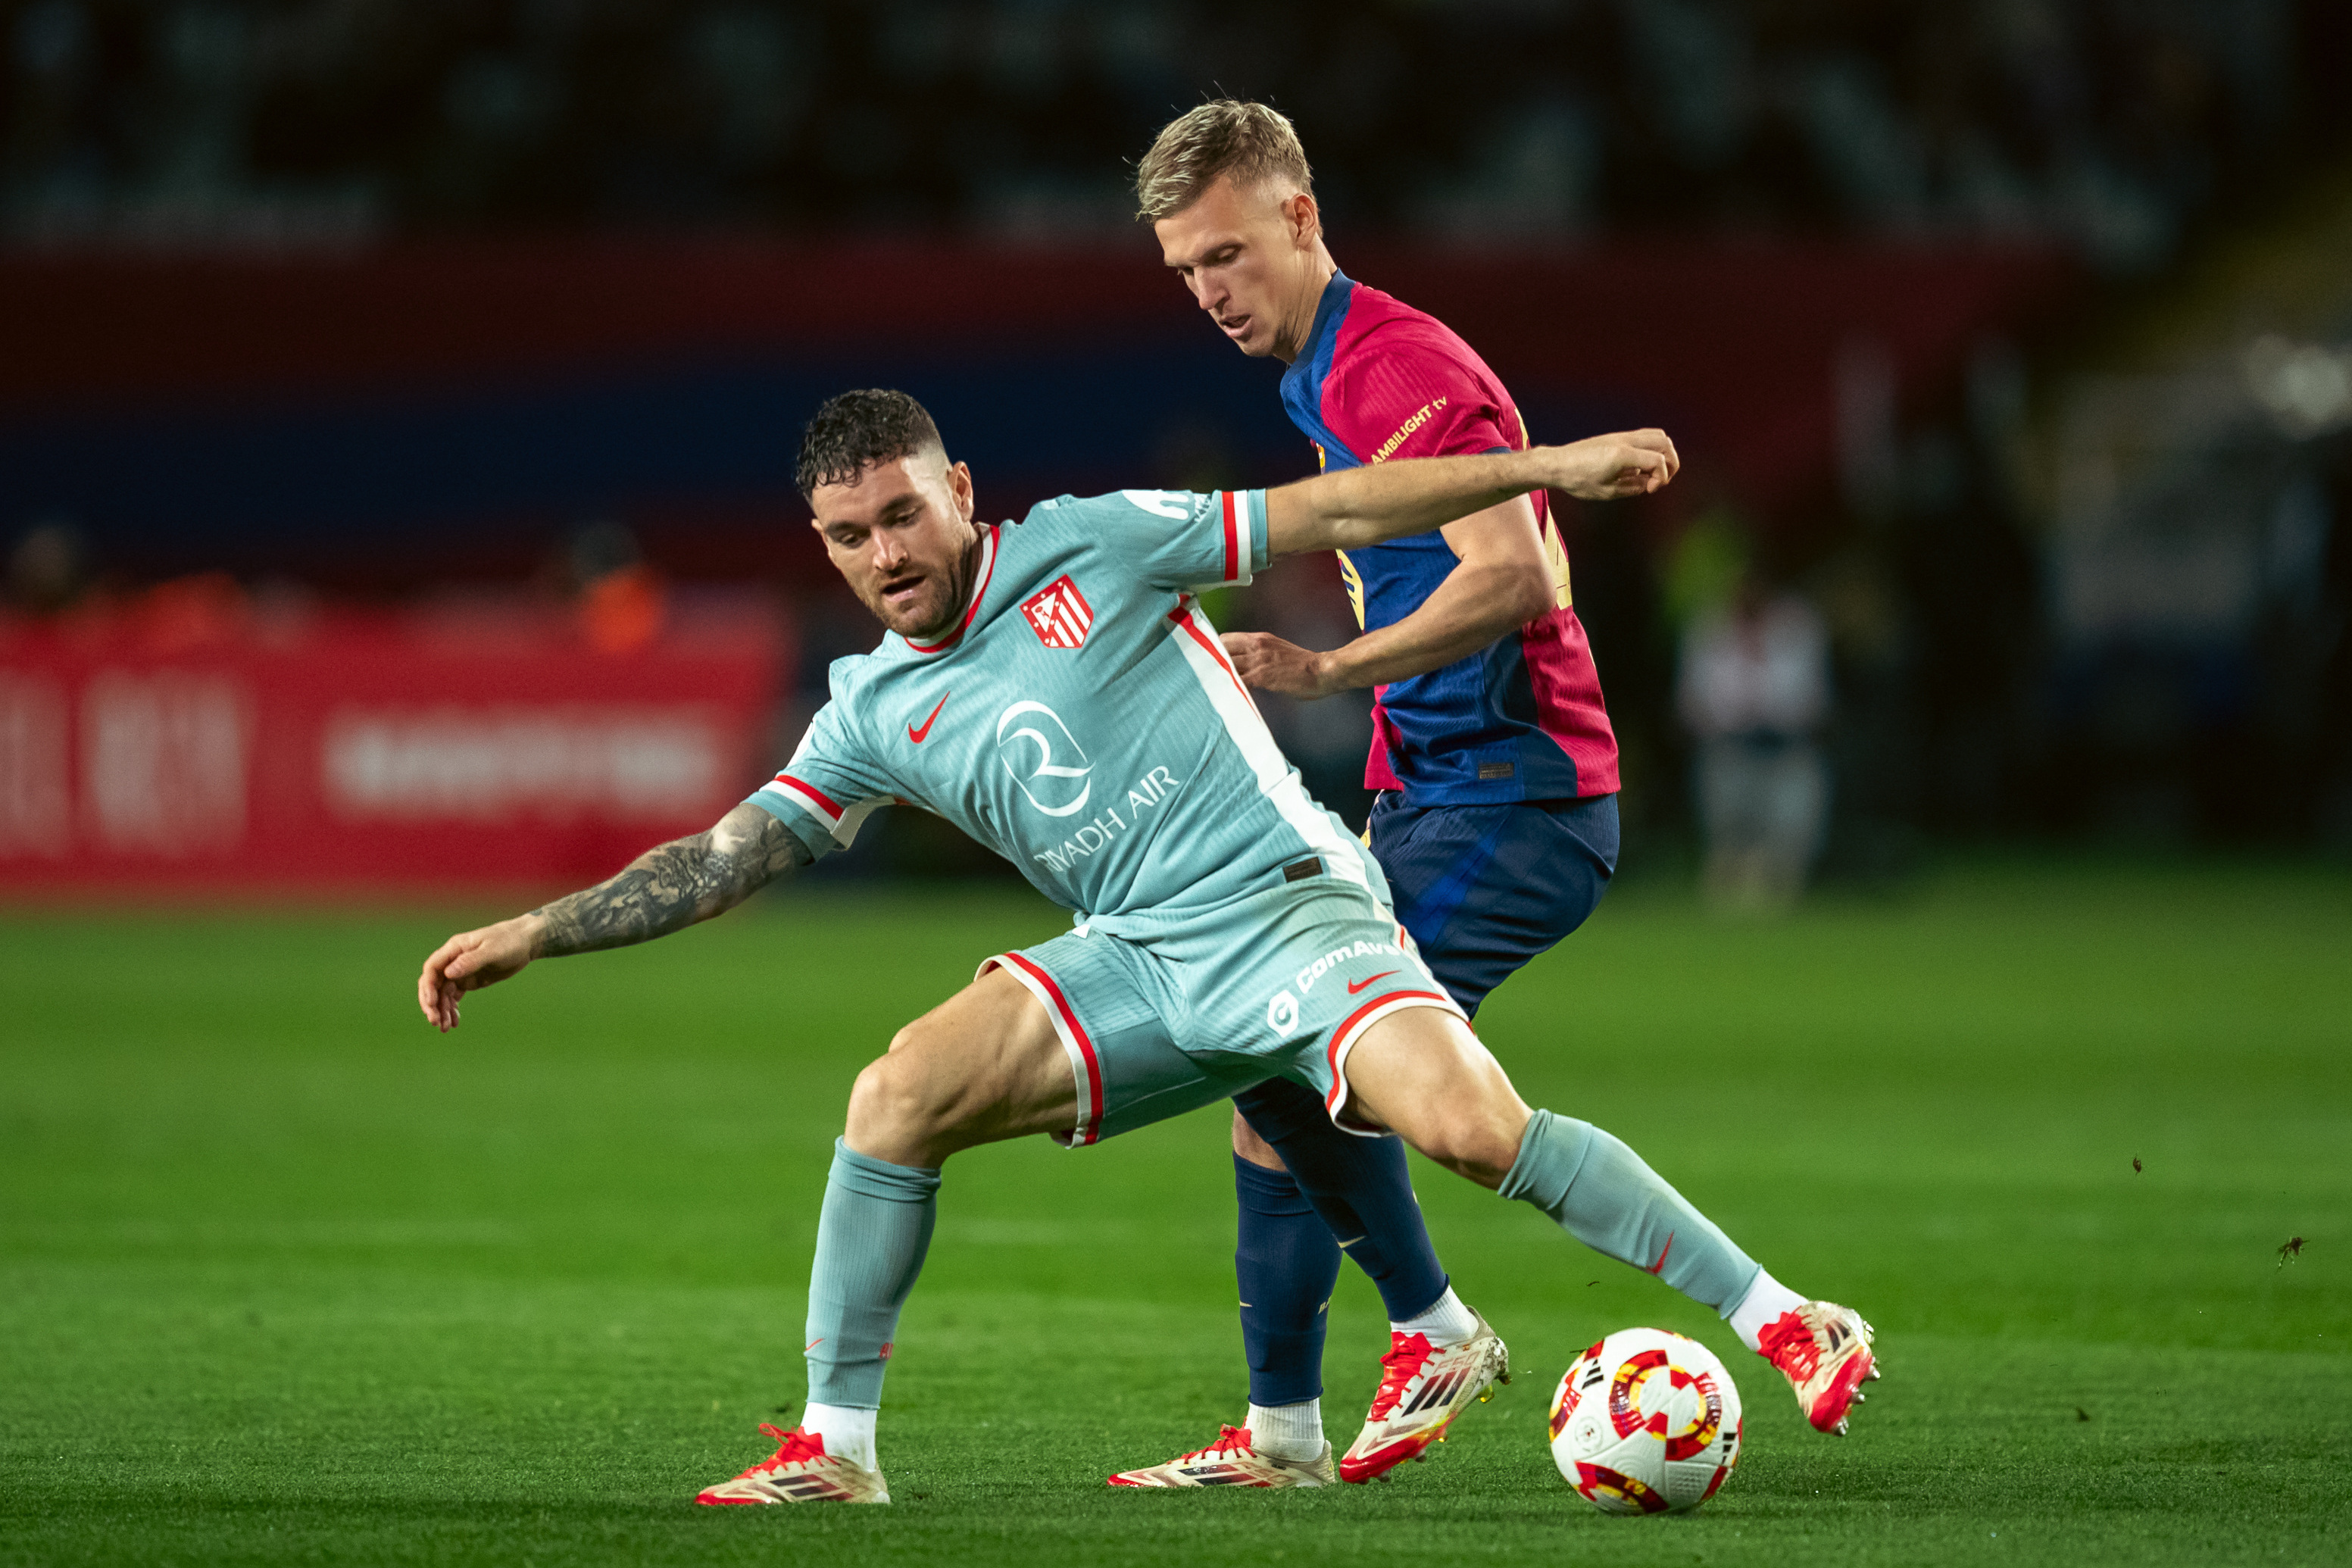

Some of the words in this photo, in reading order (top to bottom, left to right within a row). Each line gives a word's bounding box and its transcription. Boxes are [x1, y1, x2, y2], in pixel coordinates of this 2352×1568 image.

[1371, 404, 1432, 465] AMBILIGHT
[1432, 395, 1448, 410] tv
[1033, 807, 1127, 872] RIYADH
[1128, 765, 1180, 820] AIR
